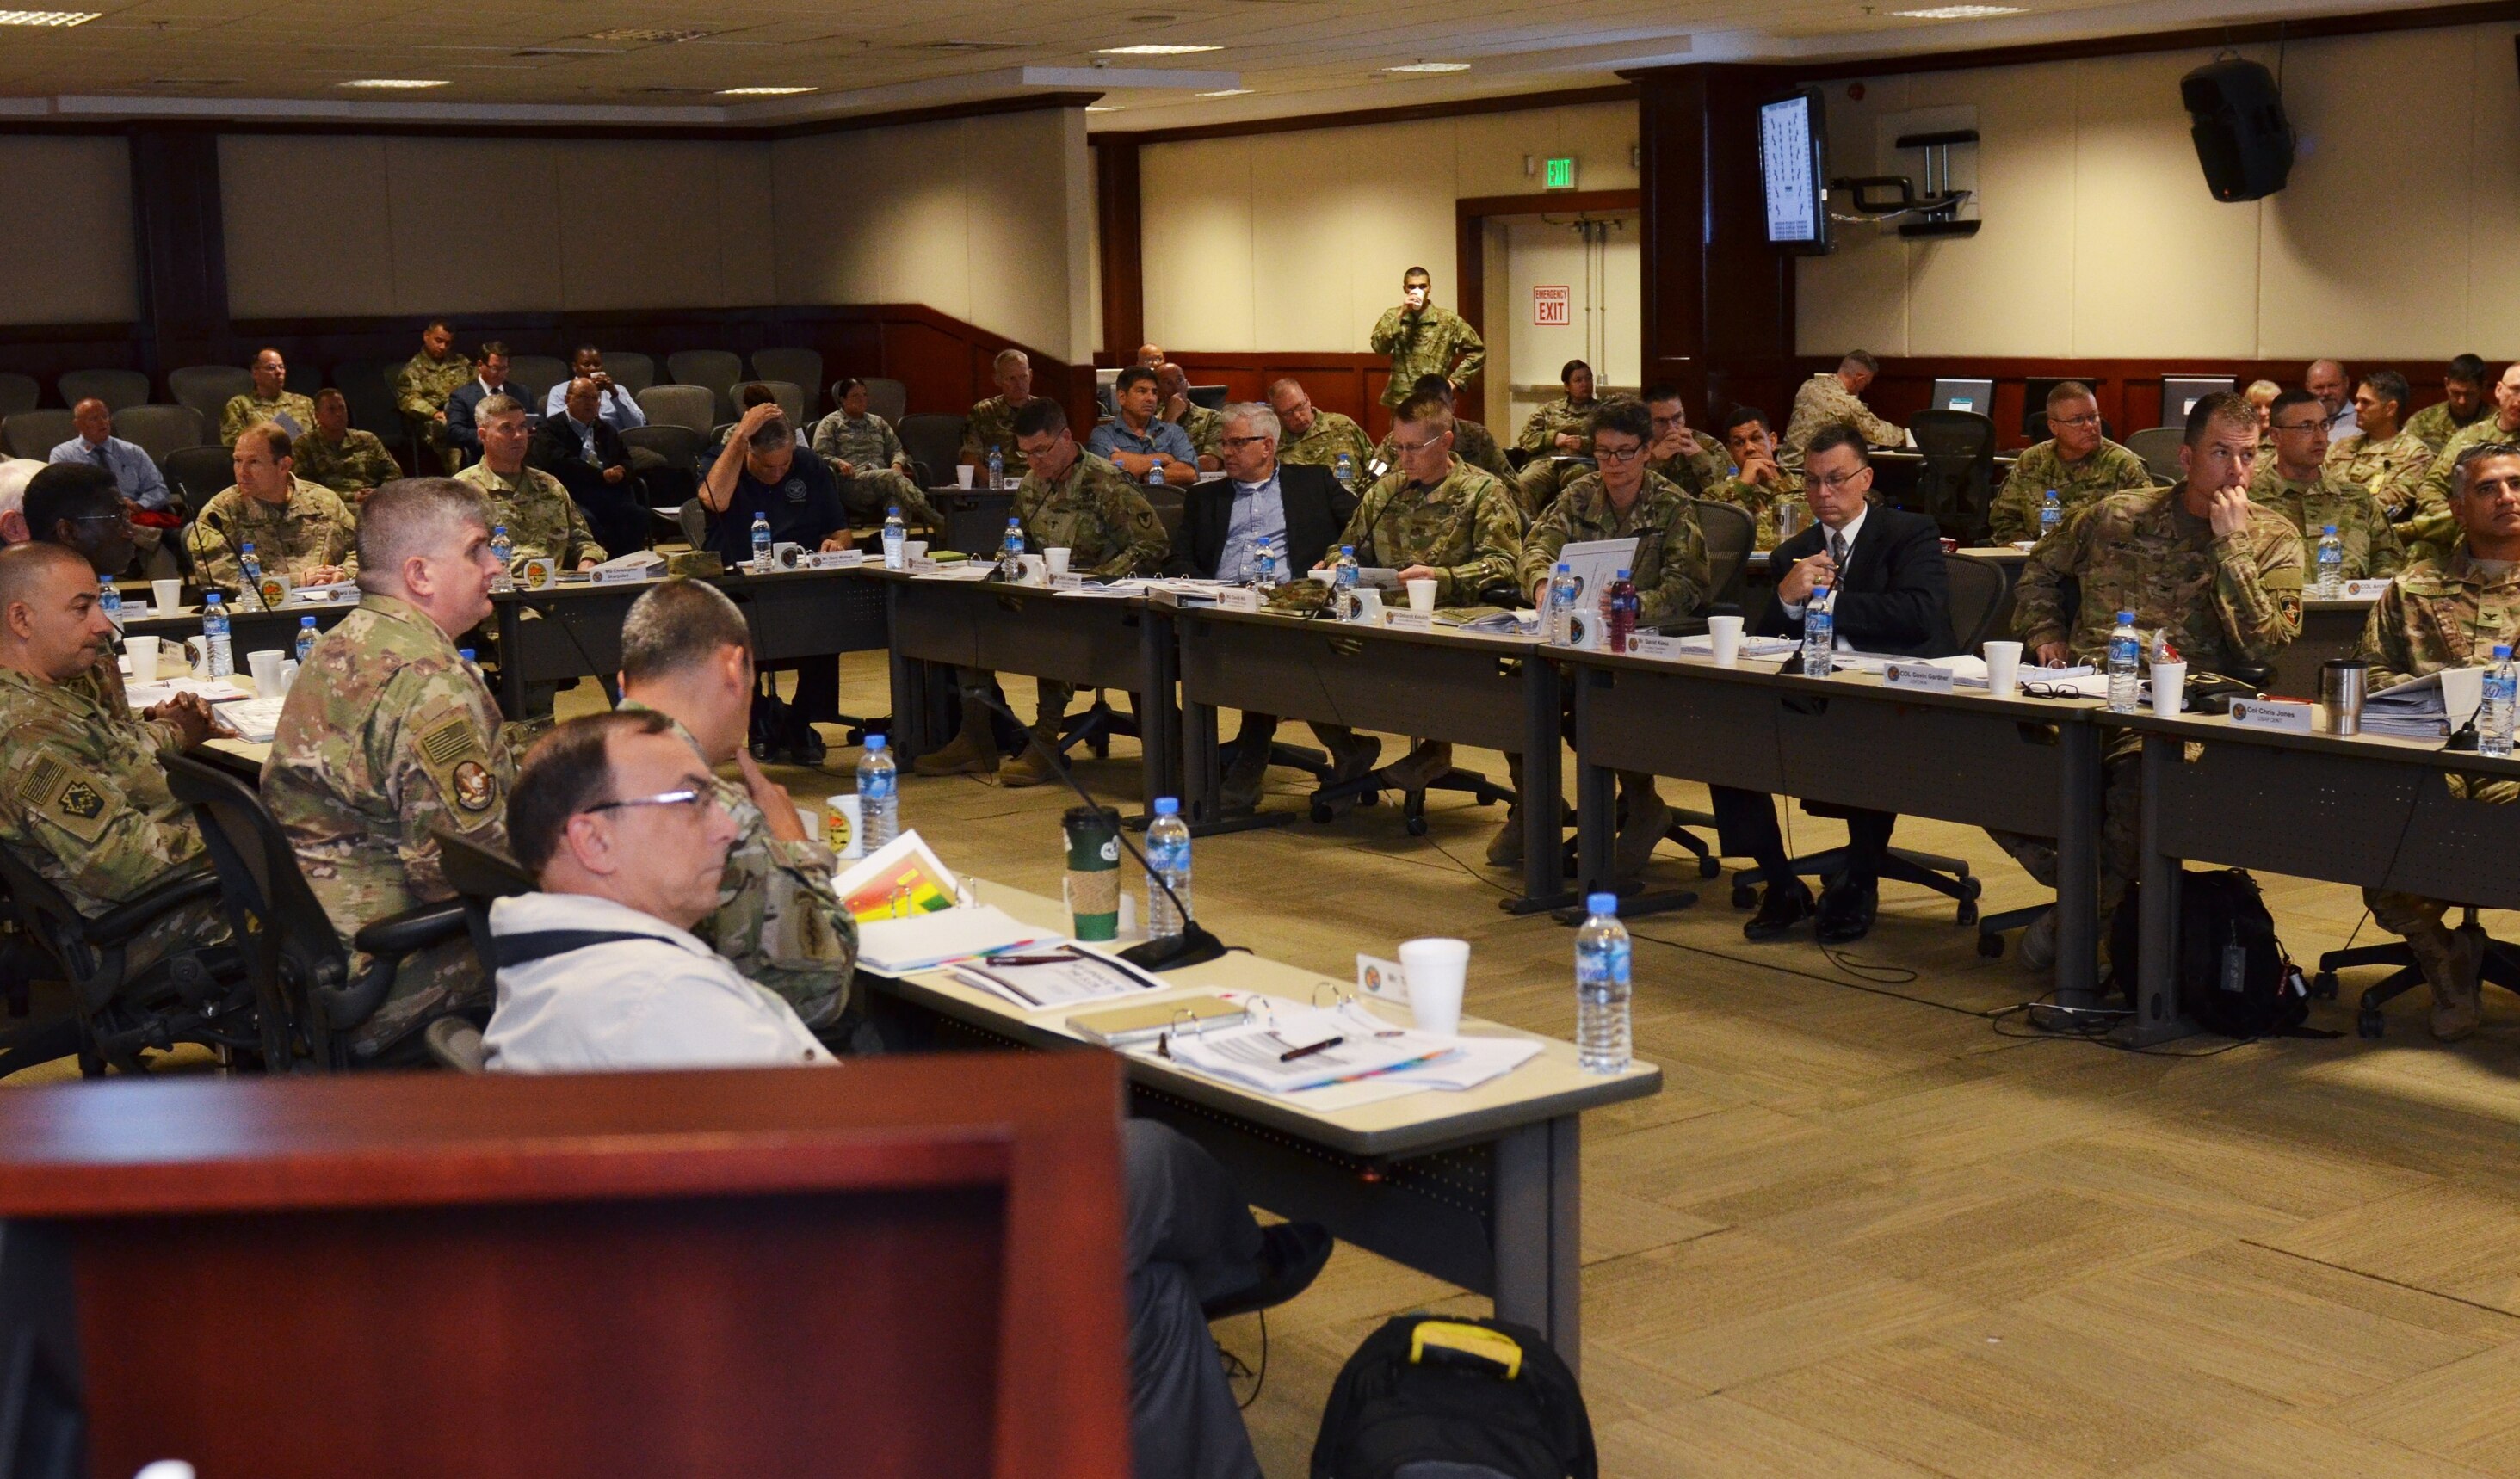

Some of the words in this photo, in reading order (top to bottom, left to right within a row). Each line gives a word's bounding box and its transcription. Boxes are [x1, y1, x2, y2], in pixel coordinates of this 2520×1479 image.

[1547, 159, 1570, 187] EXIT
[1535, 289, 1566, 299] EMERGENCY
[1539, 302, 1564, 320] EXIT
[2258, 707, 2275, 716] Chris
